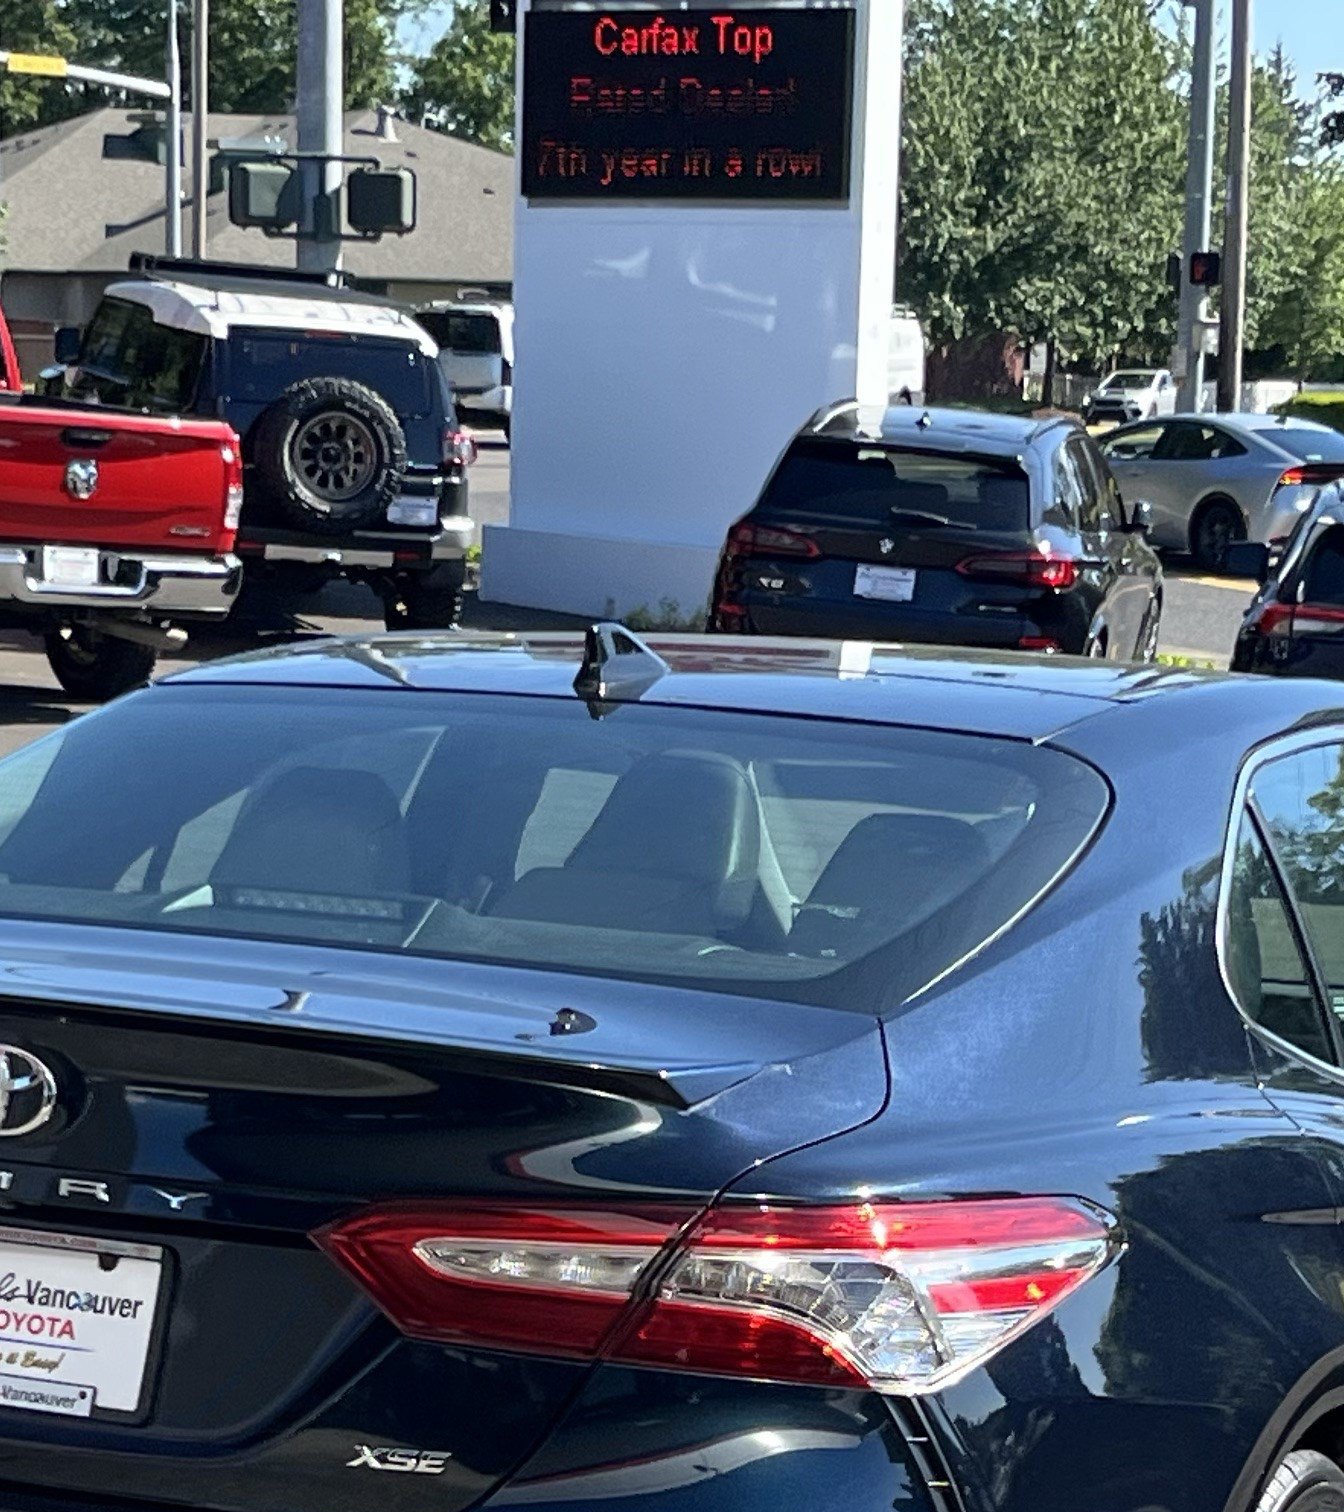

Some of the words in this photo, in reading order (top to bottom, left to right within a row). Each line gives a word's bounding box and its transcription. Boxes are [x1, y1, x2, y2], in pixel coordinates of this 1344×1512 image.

[594, 17, 700, 56] Carfax
[710, 15, 774, 63] Top
[537, 138, 588, 177] 7th
[600, 146, 672, 186] year
[683, 145, 713, 177] in
[724, 148, 744, 178] a
[26, 1279, 143, 1320] Vancouver
[1, 1385, 77, 1409] Vancouver
[345, 1445, 454, 1475] XSE
